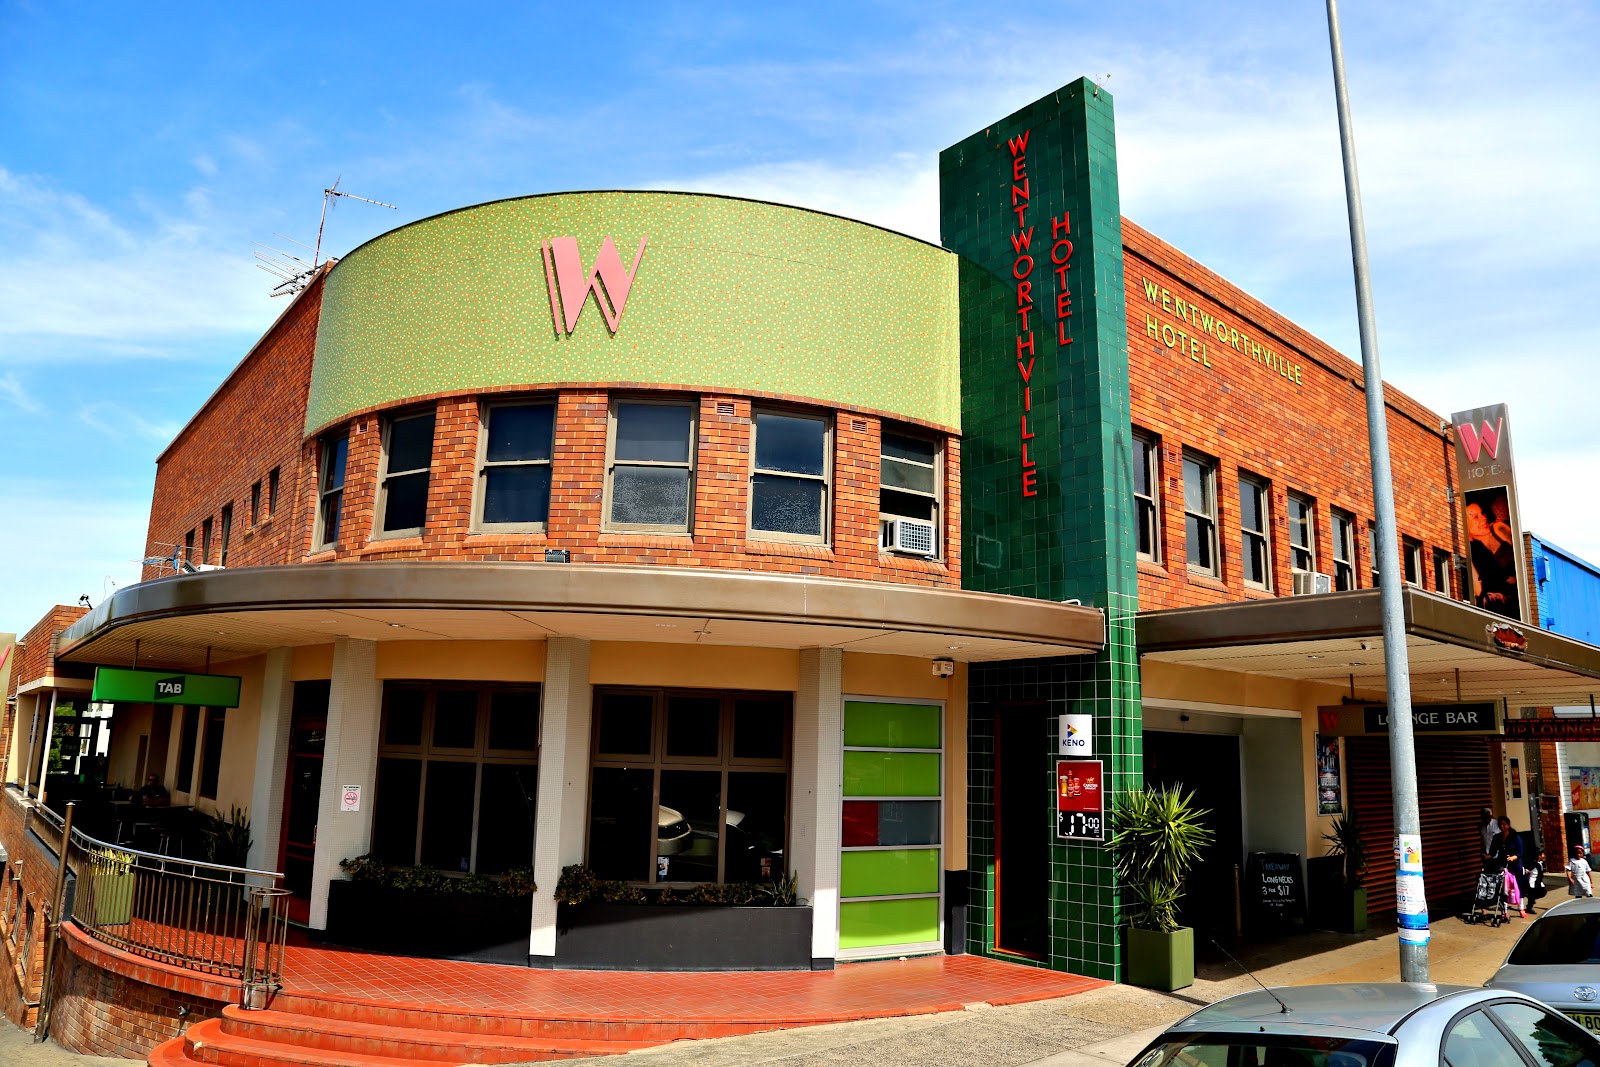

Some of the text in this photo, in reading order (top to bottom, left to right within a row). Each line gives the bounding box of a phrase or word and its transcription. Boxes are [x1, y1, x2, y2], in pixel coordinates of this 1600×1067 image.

[540, 235, 648, 337] W
[1051, 210, 1074, 346] HOTEL
[1007, 129, 1037, 498] WENTWORTHVILLE
[1141, 276, 1303, 387] WENTWORTHVILLE
[1145, 313, 1212, 369] HOTEL
[1456, 416, 1502, 464] W
[158, 682, 182, 694] TAB
[1062, 739, 1085, 747] KENO
[1378, 711, 1478, 726] LNGE BAR
[1261, 886, 1268, 896] 3
[1277, 884, 1290, 896] $17
